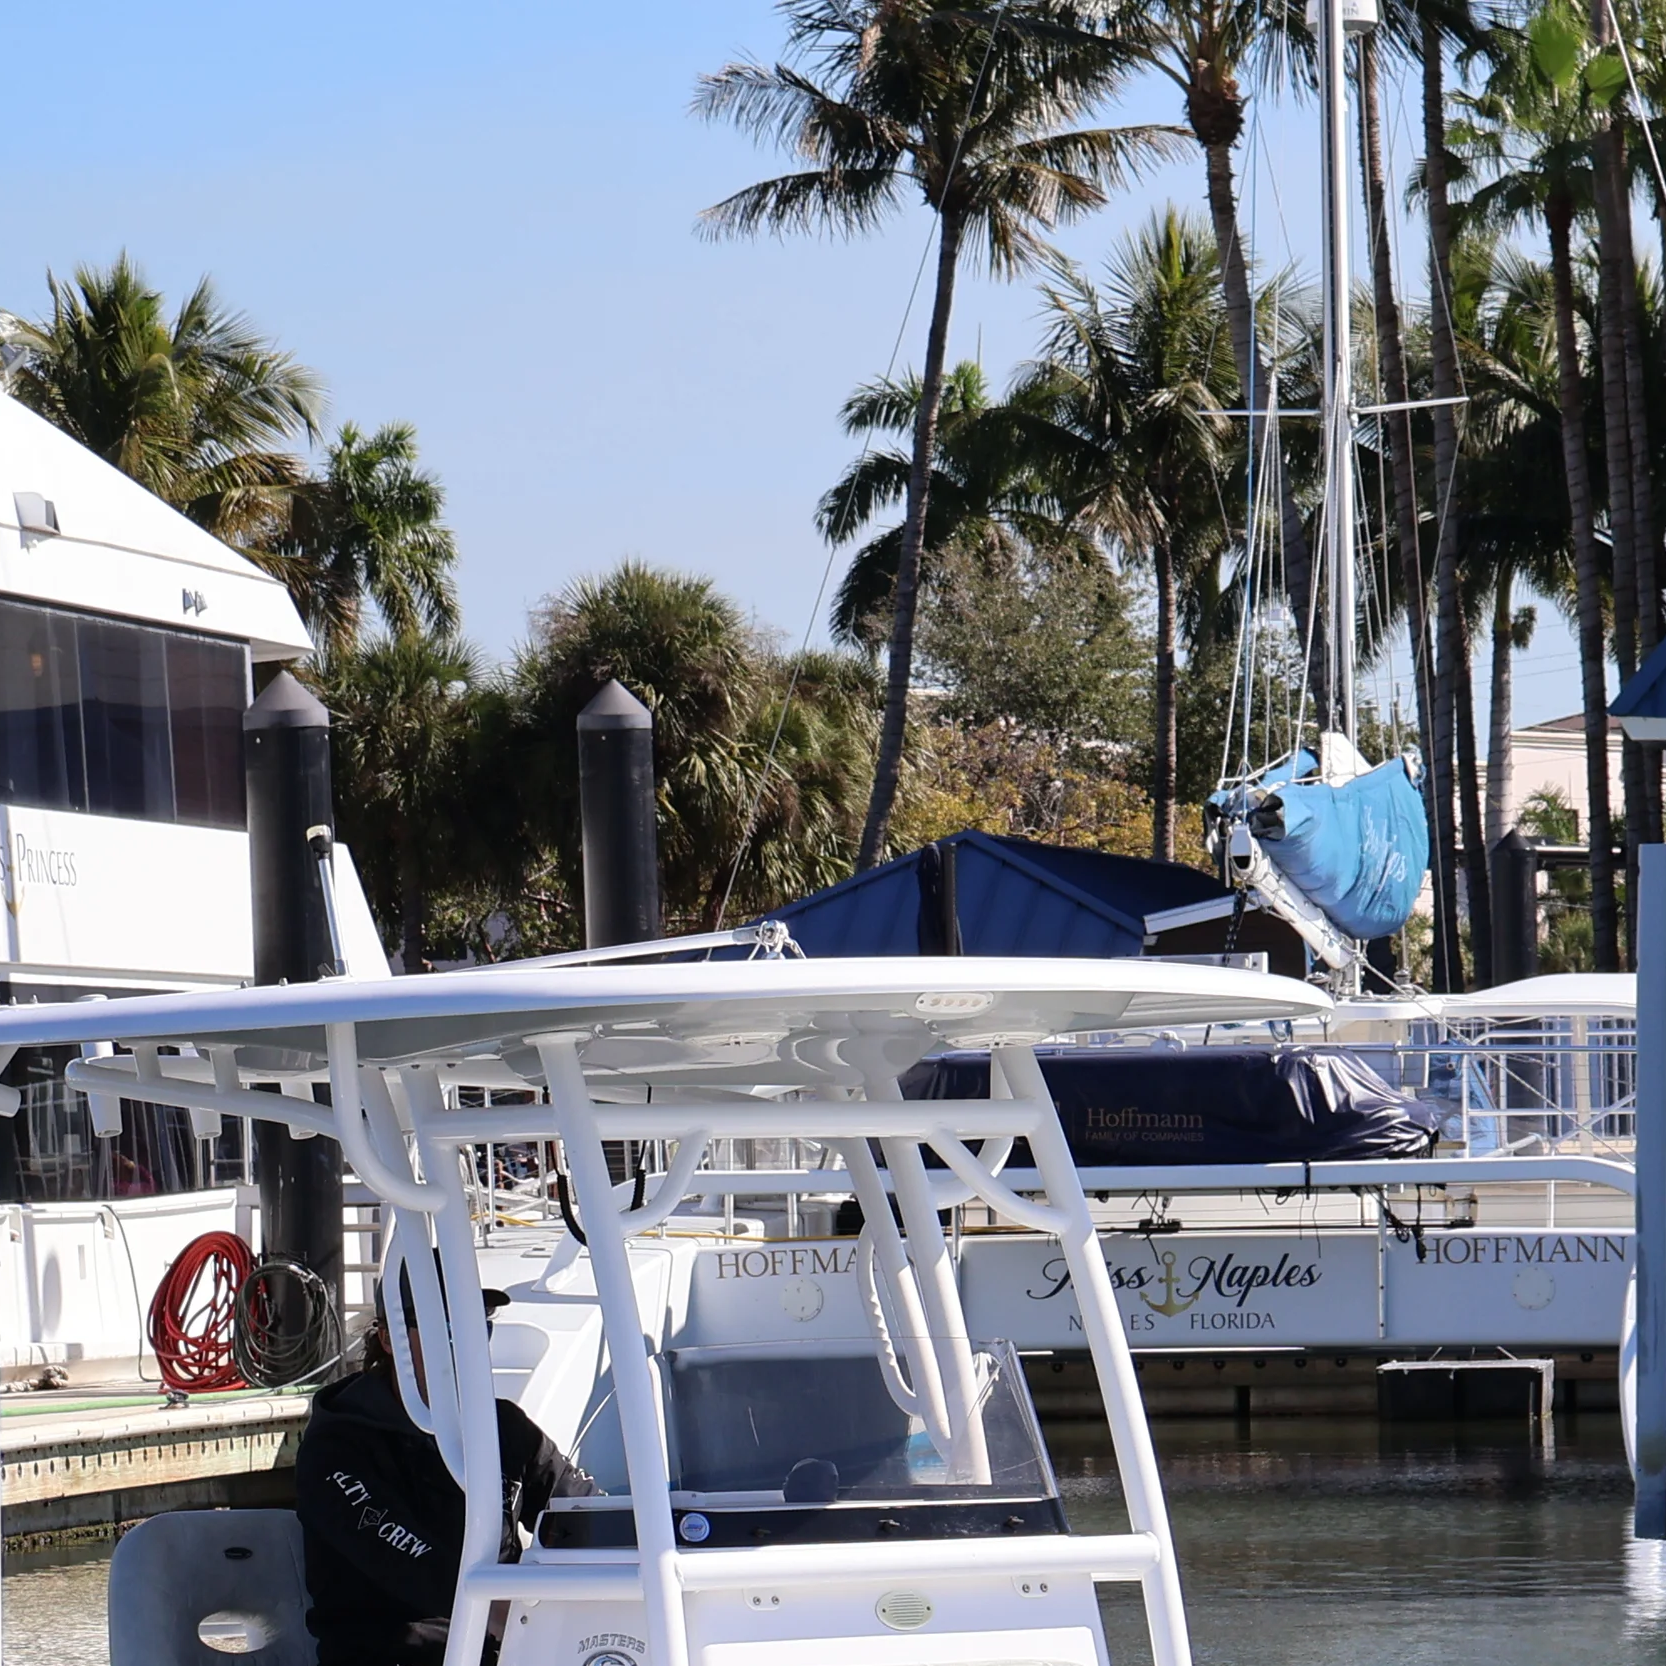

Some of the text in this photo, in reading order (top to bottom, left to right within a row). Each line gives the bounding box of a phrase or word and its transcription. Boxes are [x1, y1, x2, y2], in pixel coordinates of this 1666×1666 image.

[16, 833, 77, 886] PRINCESS
[1087, 1107, 1204, 1128] Hoffmann
[1085, 1132, 1204, 1142] FAMILY OF COMPANIES
[1416, 1236, 1628, 1264] HOFFMANN
[1176, 1253, 1322, 1307] Naples
[1190, 1313, 1275, 1329] FLORIDA
[378, 1522, 432, 1558] CREW
[577, 1633, 645, 1654] MASTERS
